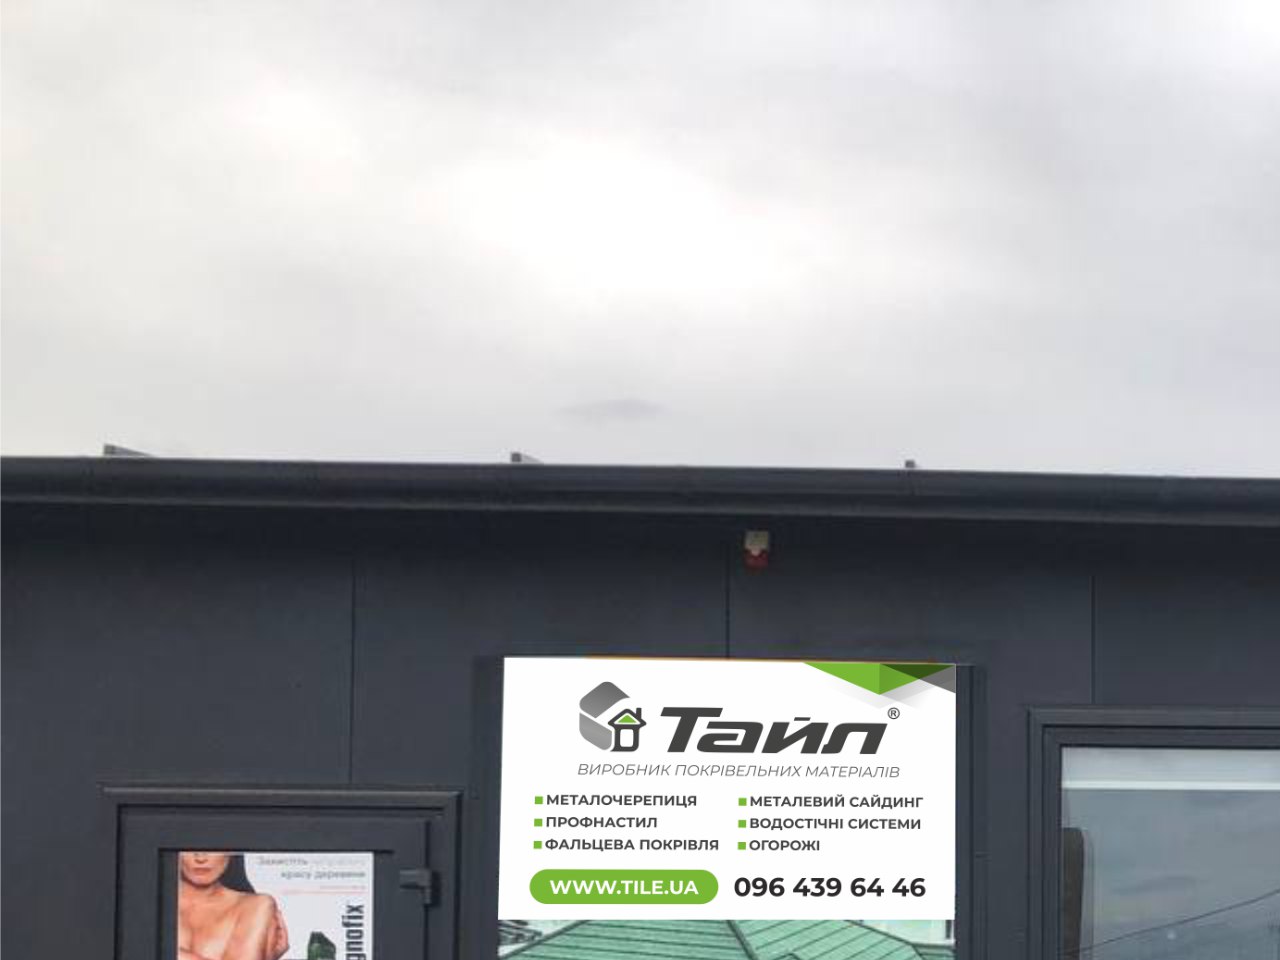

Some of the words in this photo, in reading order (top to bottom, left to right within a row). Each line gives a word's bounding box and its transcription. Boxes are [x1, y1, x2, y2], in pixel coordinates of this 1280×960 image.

[660, 706, 887, 755] Тайл
[577, 763, 672, 776] ВИРОБНИК
[674, 764, 802, 777] ПОКРІВЕЛЬНИХ
[804, 765, 900, 778] МАТЕРІАЛІВ
[546, 794, 697, 809] МЕТАЛОЧЕРЕПИЦЯ
[750, 794, 845, 808] МЕТАЛЕВИЙ
[849, 795, 924, 810] САЙДИНГ
[545, 816, 658, 829] ПРОФНАСТИЛ
[750, 817, 844, 831] ВОДОСТІЧНІ
[848, 818, 921, 830] СИСТЕМИ
[544, 838, 636, 852] ФАЛЬЦЕВА
[639, 838, 719, 851] ПОКРІВЛЯ
[749, 839, 820, 852] ОГОРОЖІ
[550, 880, 699, 895] WWW.TILE.UA
[734, 877, 786, 898] 096
[792, 877, 842, 898] 439
[849, 877, 885, 898] 64
[891, 877, 927, 898] 46
